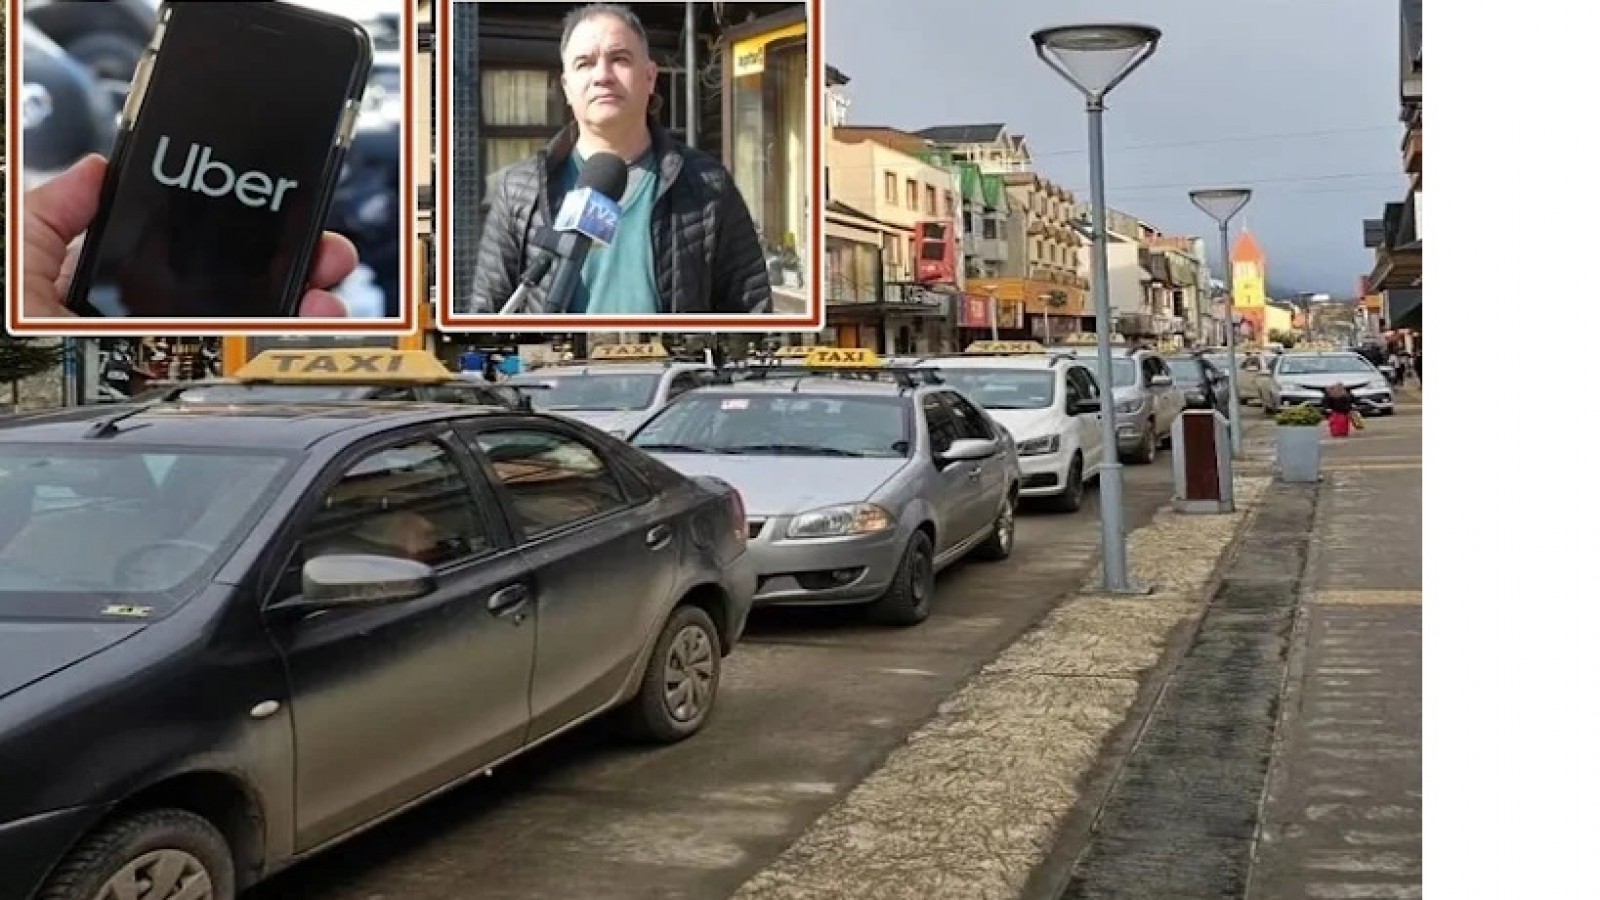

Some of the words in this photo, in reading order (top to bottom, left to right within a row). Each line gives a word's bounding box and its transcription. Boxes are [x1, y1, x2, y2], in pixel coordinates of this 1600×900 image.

[152, 135, 298, 212] Uber
[602, 345, 654, 355] TAXI
[818, 351, 864, 362] TAXI
[270, 355, 404, 373] TAXI
